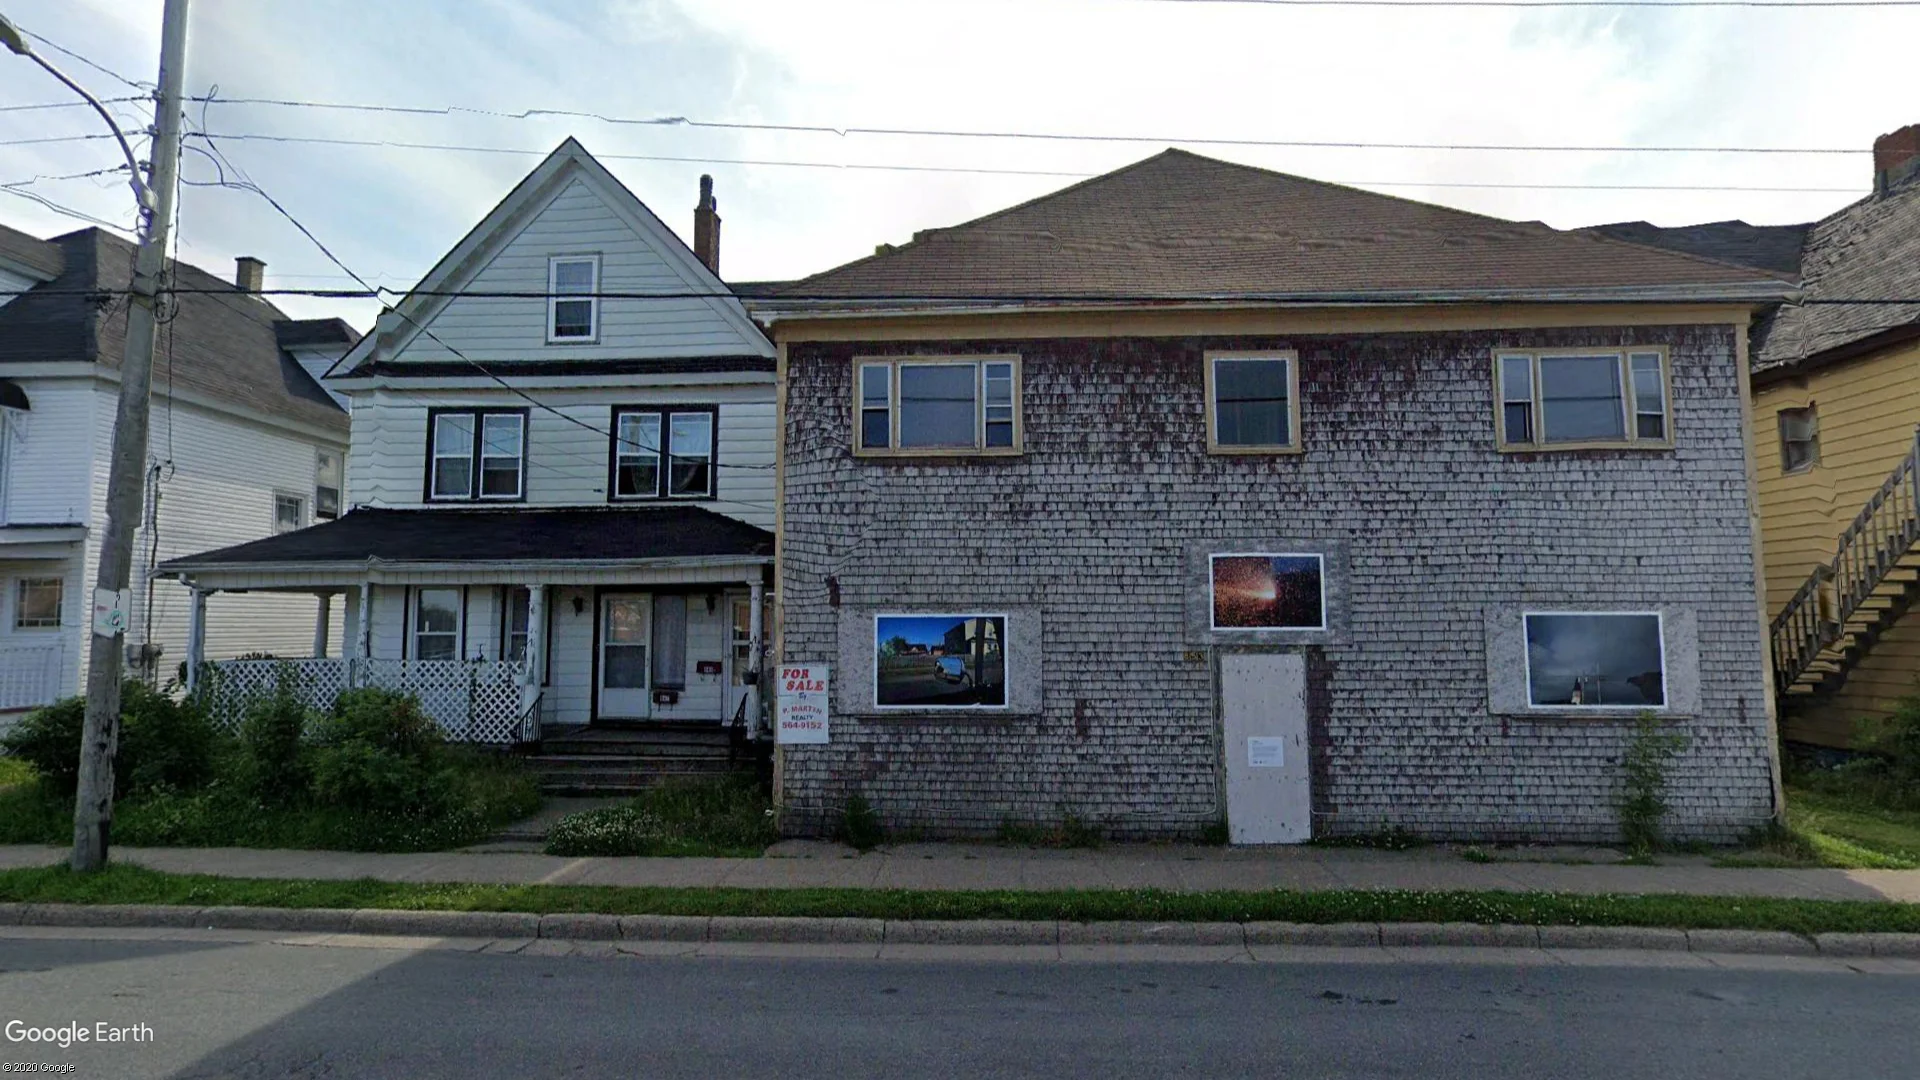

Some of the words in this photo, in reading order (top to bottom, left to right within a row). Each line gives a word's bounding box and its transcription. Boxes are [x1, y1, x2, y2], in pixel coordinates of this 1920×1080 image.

[782, 669, 809, 679] FOR
[786, 680, 825, 691] SALE
[791, 705, 822, 715] MARTIN
